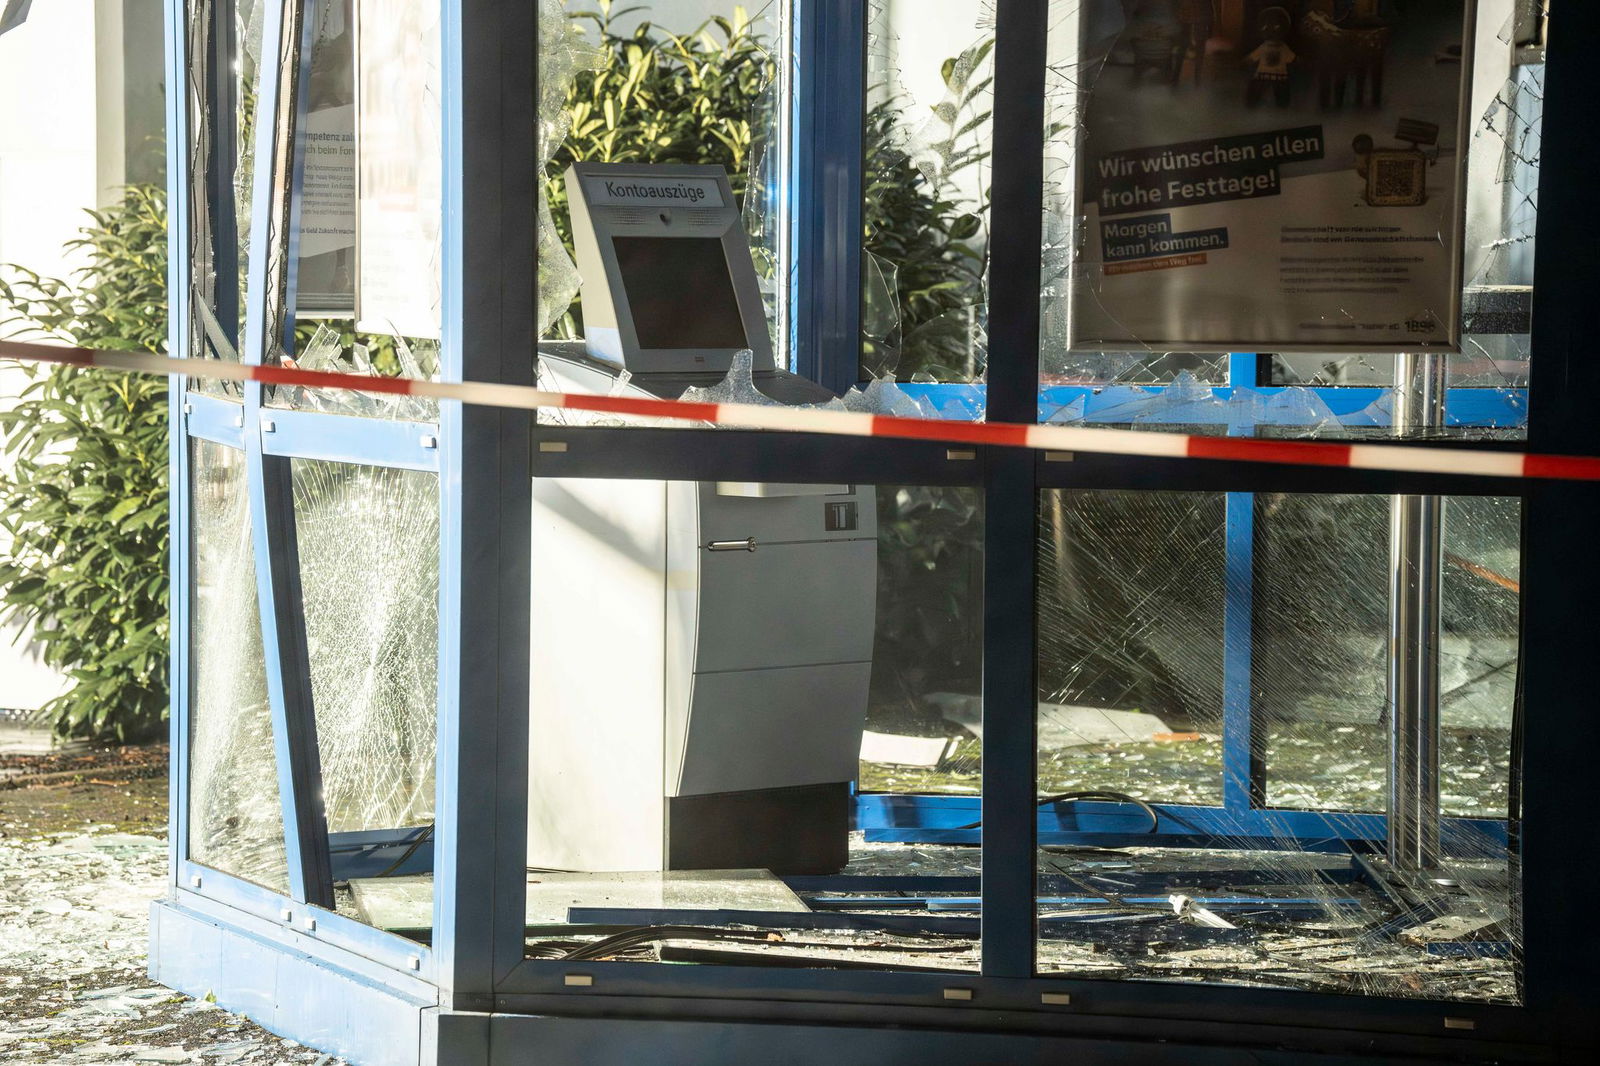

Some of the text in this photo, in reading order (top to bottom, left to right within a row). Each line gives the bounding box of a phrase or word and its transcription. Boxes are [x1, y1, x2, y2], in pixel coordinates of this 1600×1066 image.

[1099, 136, 1319, 178] Wir wünschen allen
[605, 181, 705, 202] Kontoauszüge
[1102, 169, 1276, 208] frohe Festtage!
[1104, 220, 1168, 239] Morgen
[1106, 232, 1225, 258] kann kommen.
